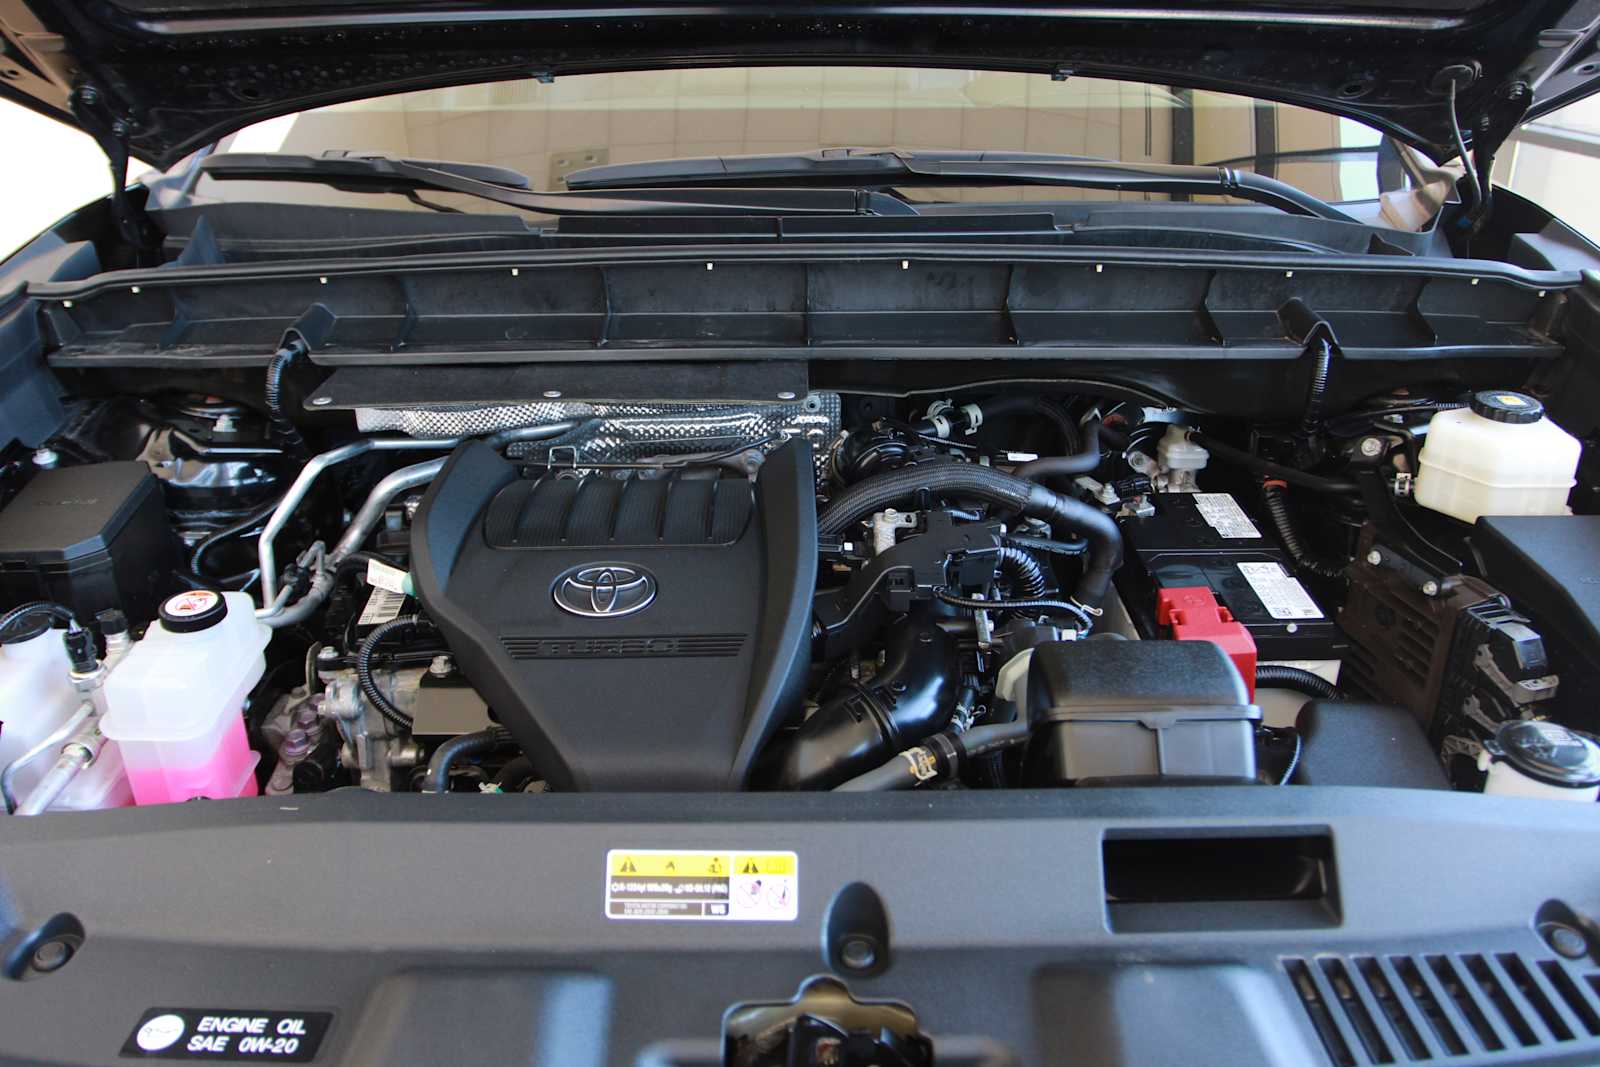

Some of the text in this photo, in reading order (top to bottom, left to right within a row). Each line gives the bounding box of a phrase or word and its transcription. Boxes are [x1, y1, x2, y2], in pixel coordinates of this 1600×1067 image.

[541, 639, 676, 656] TURBO
[197, 1016, 306, 1035] ENGINE OIL
[187, 1035, 299, 1054] SAE 0W-20
